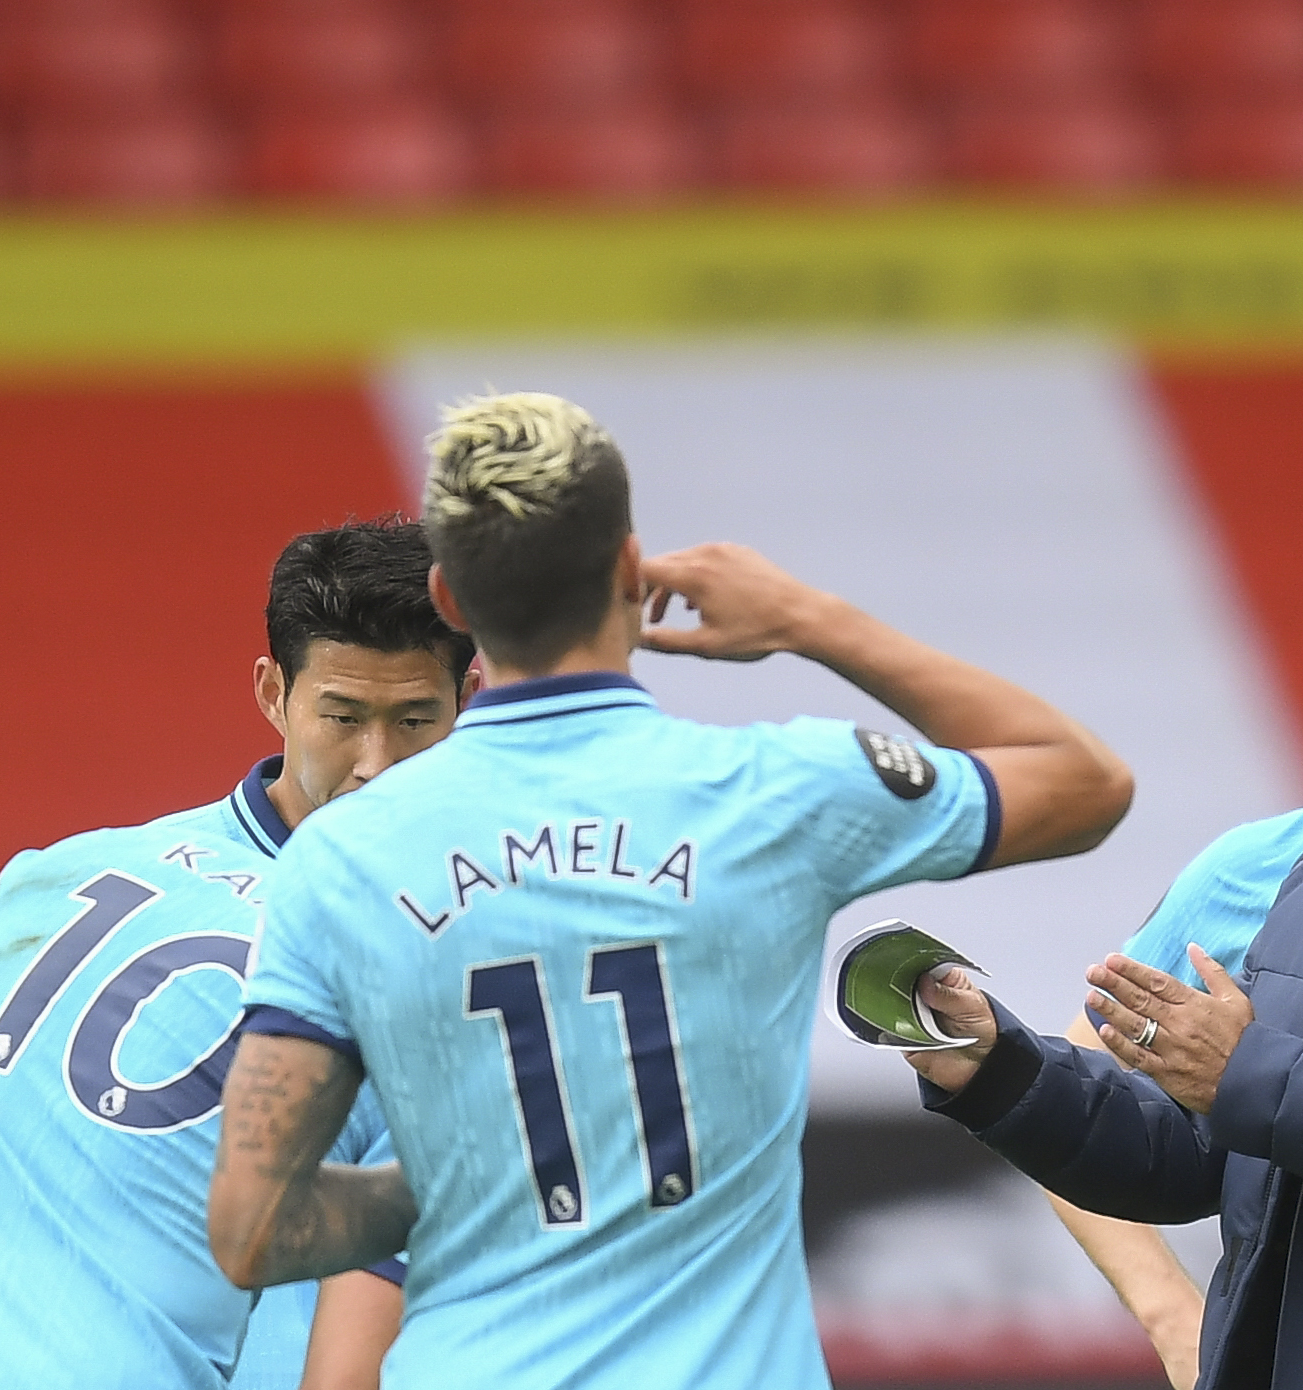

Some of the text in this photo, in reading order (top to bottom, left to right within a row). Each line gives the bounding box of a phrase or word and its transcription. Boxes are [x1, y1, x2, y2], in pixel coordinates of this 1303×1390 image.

[161, 842, 266, 908] KA
[394, 816, 698, 940] LAMELA
[462, 939, 698, 1232] 11
